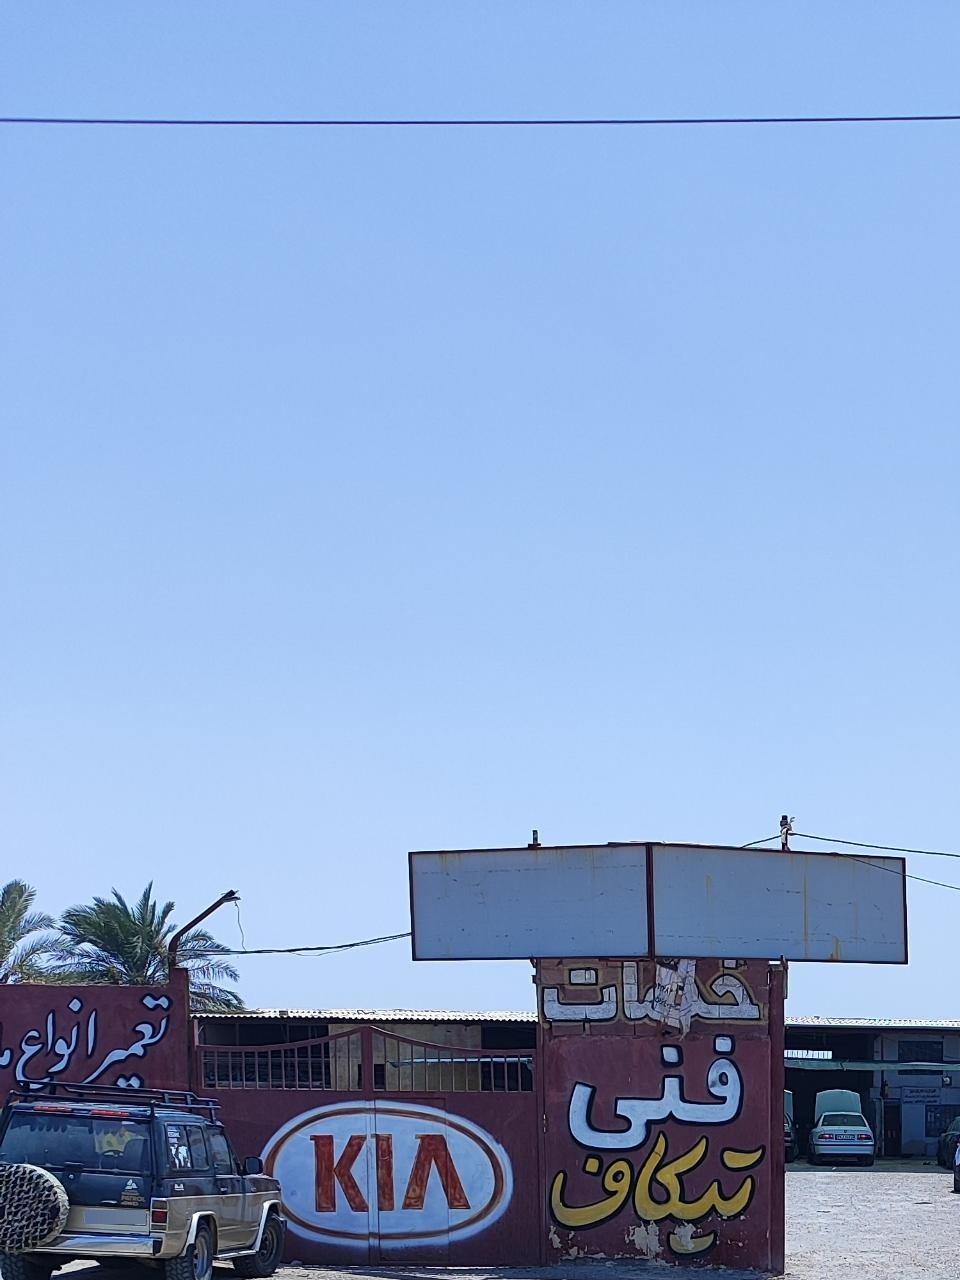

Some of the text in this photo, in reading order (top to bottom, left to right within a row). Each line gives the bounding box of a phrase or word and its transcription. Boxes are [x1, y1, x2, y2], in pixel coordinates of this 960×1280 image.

[15, 998, 97, 1090] انواع
[82, 994, 170, 1089] تعمیر
[568, 1033, 744, 1151] فنی
[309, 1134, 472, 1213] KIA
[550, 1131, 767, 1257] تیکاف
